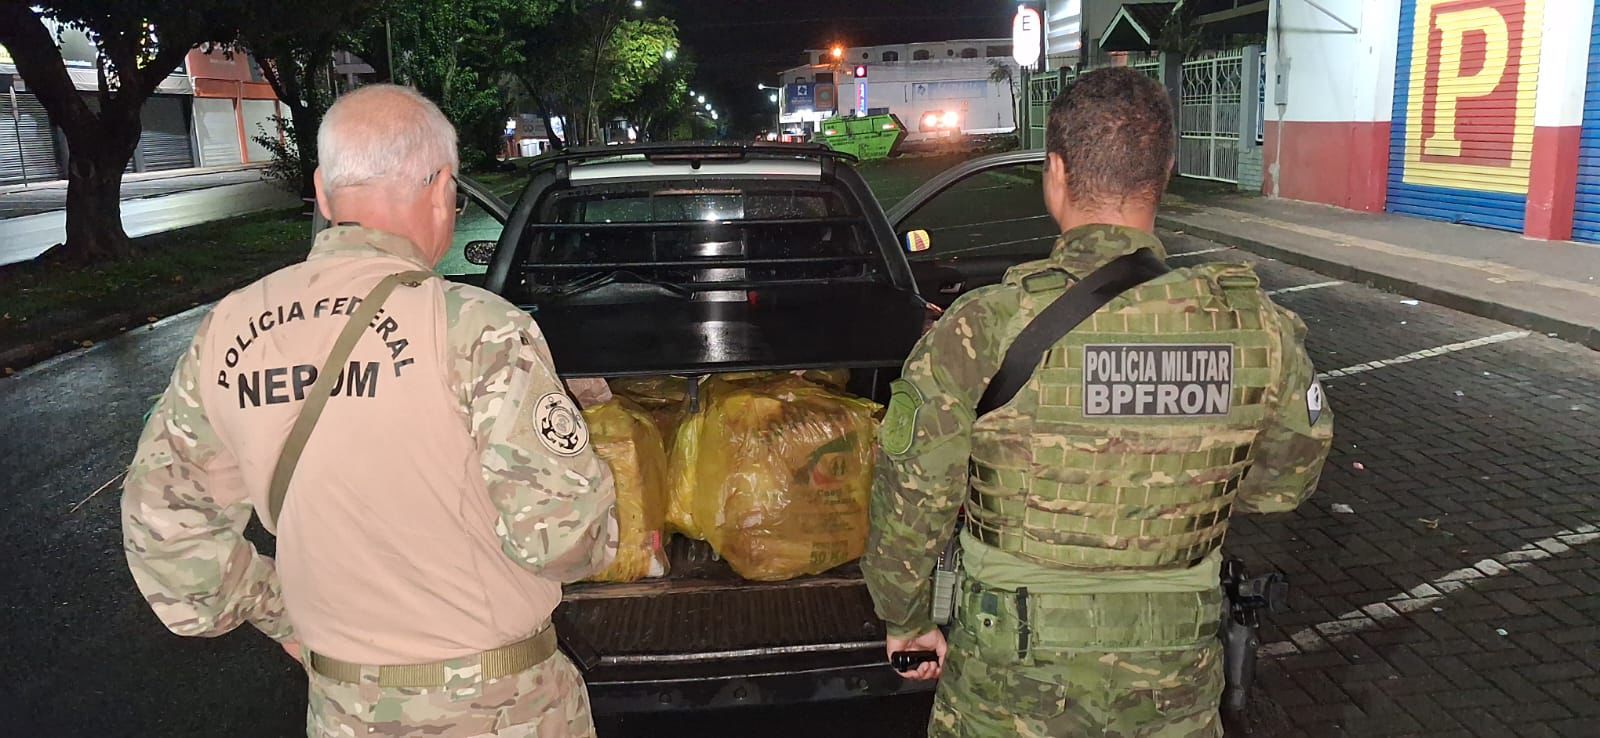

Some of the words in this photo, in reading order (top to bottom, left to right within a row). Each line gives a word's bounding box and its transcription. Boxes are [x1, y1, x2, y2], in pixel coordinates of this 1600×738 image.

[1022, 15, 1032, 31] E
[1424, 6, 1509, 157] P
[217, 301, 305, 389] POLÍCIA
[1086, 347, 1157, 382] POLÍCIA
[1161, 350, 1230, 382] MILITAR
[1087, 383, 1229, 414] BPFRON
